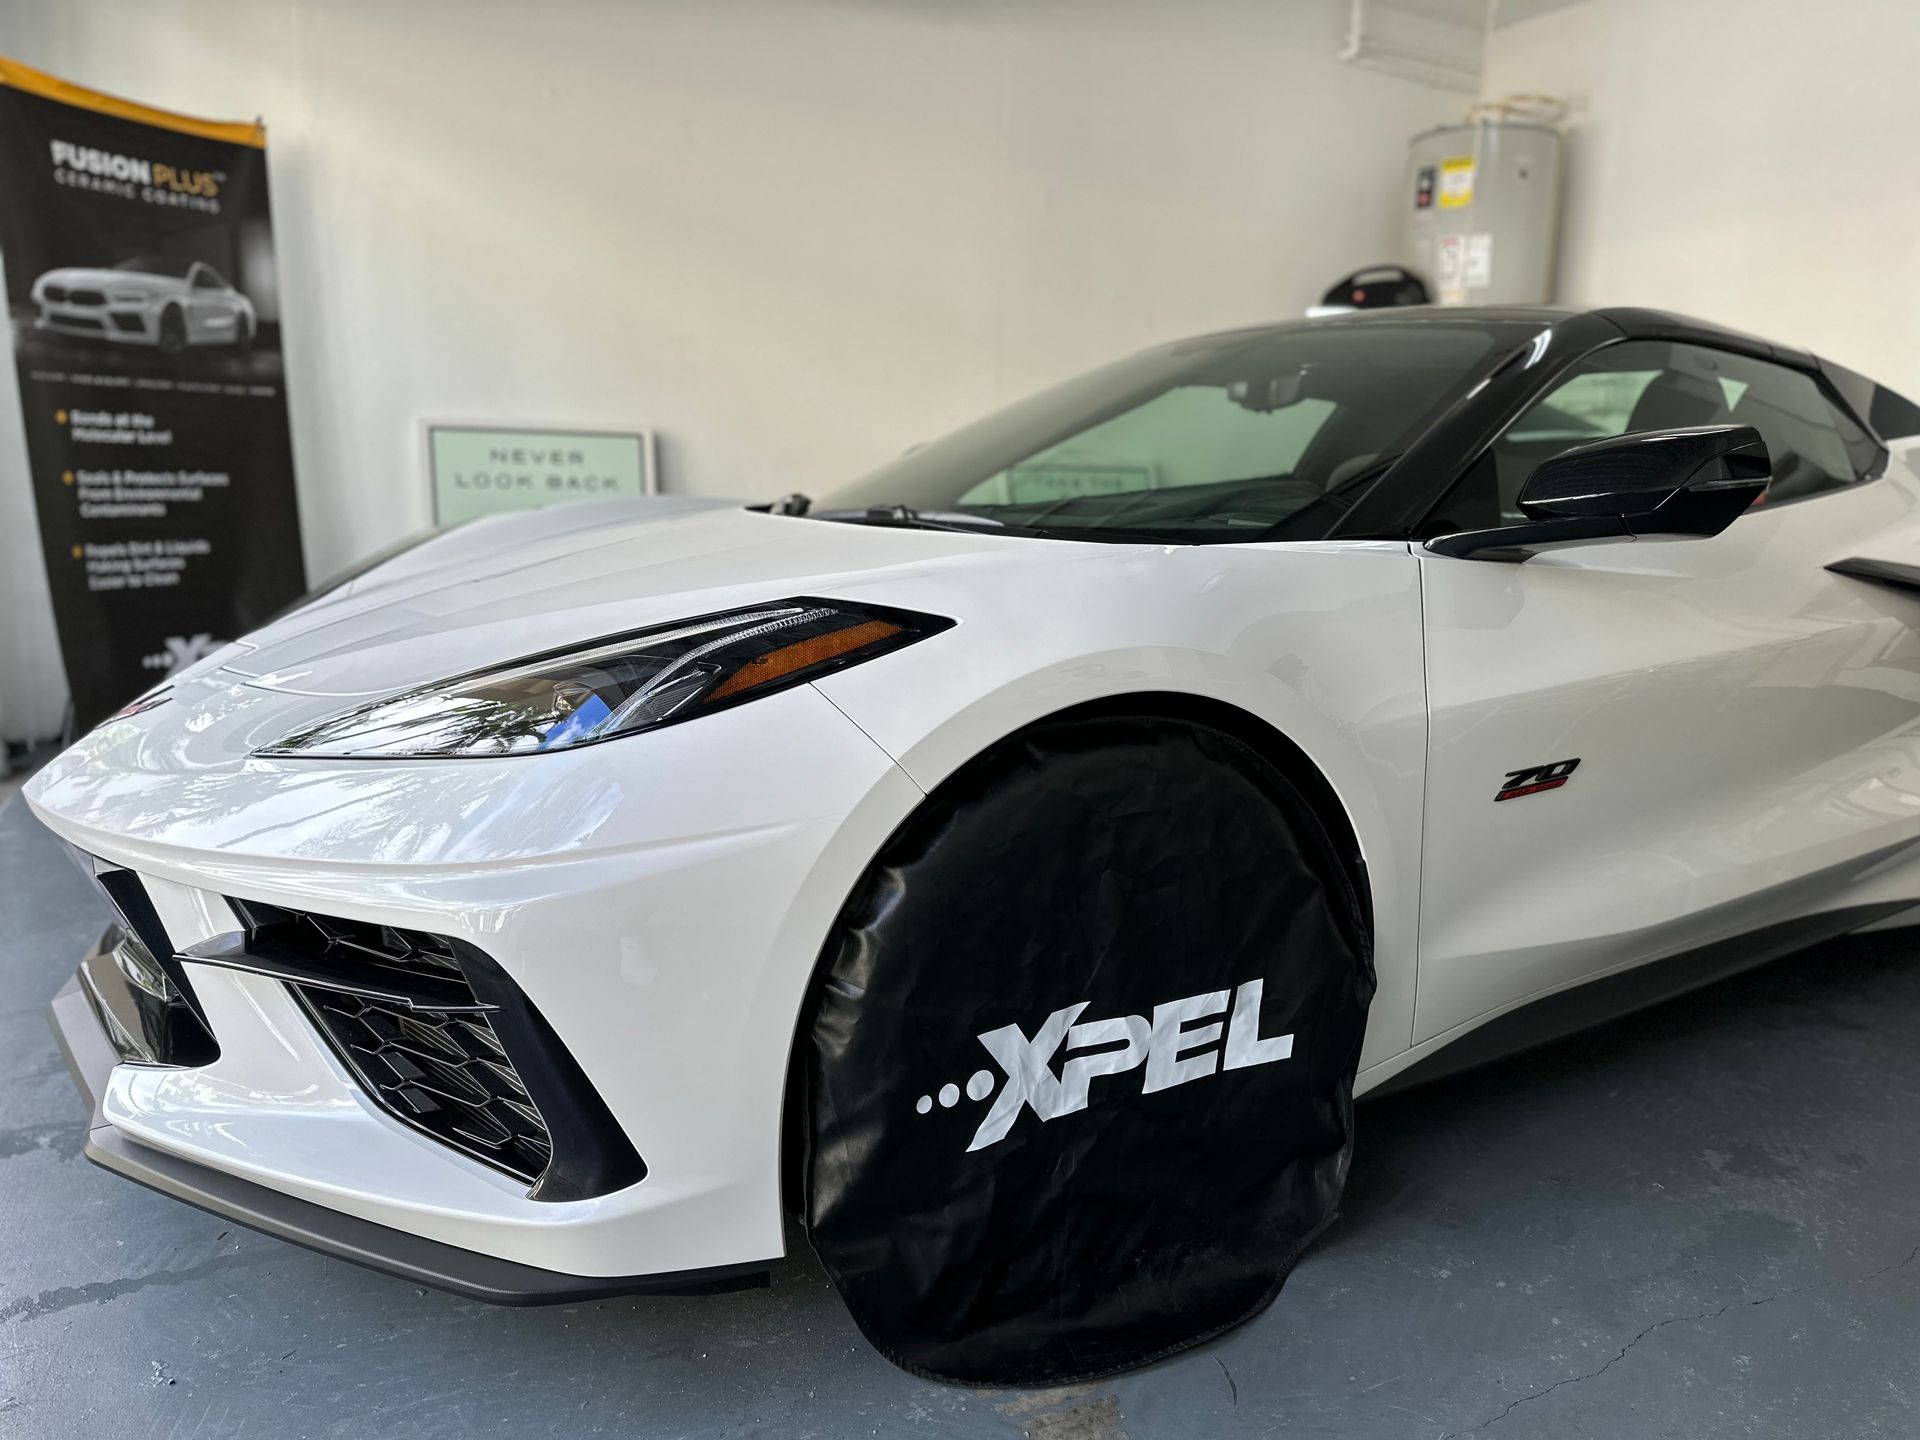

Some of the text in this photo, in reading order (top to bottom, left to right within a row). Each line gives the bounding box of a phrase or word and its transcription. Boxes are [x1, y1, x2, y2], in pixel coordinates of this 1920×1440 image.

[50, 139, 149, 185] FUSION
[54, 167, 221, 214] CERAMIC COATING
[489, 447, 585, 466] NEVER
[453, 472, 620, 492] LOOK BACK
[1501, 757, 1581, 790] 70
[965, 977, 1295, 1153] XPEL
